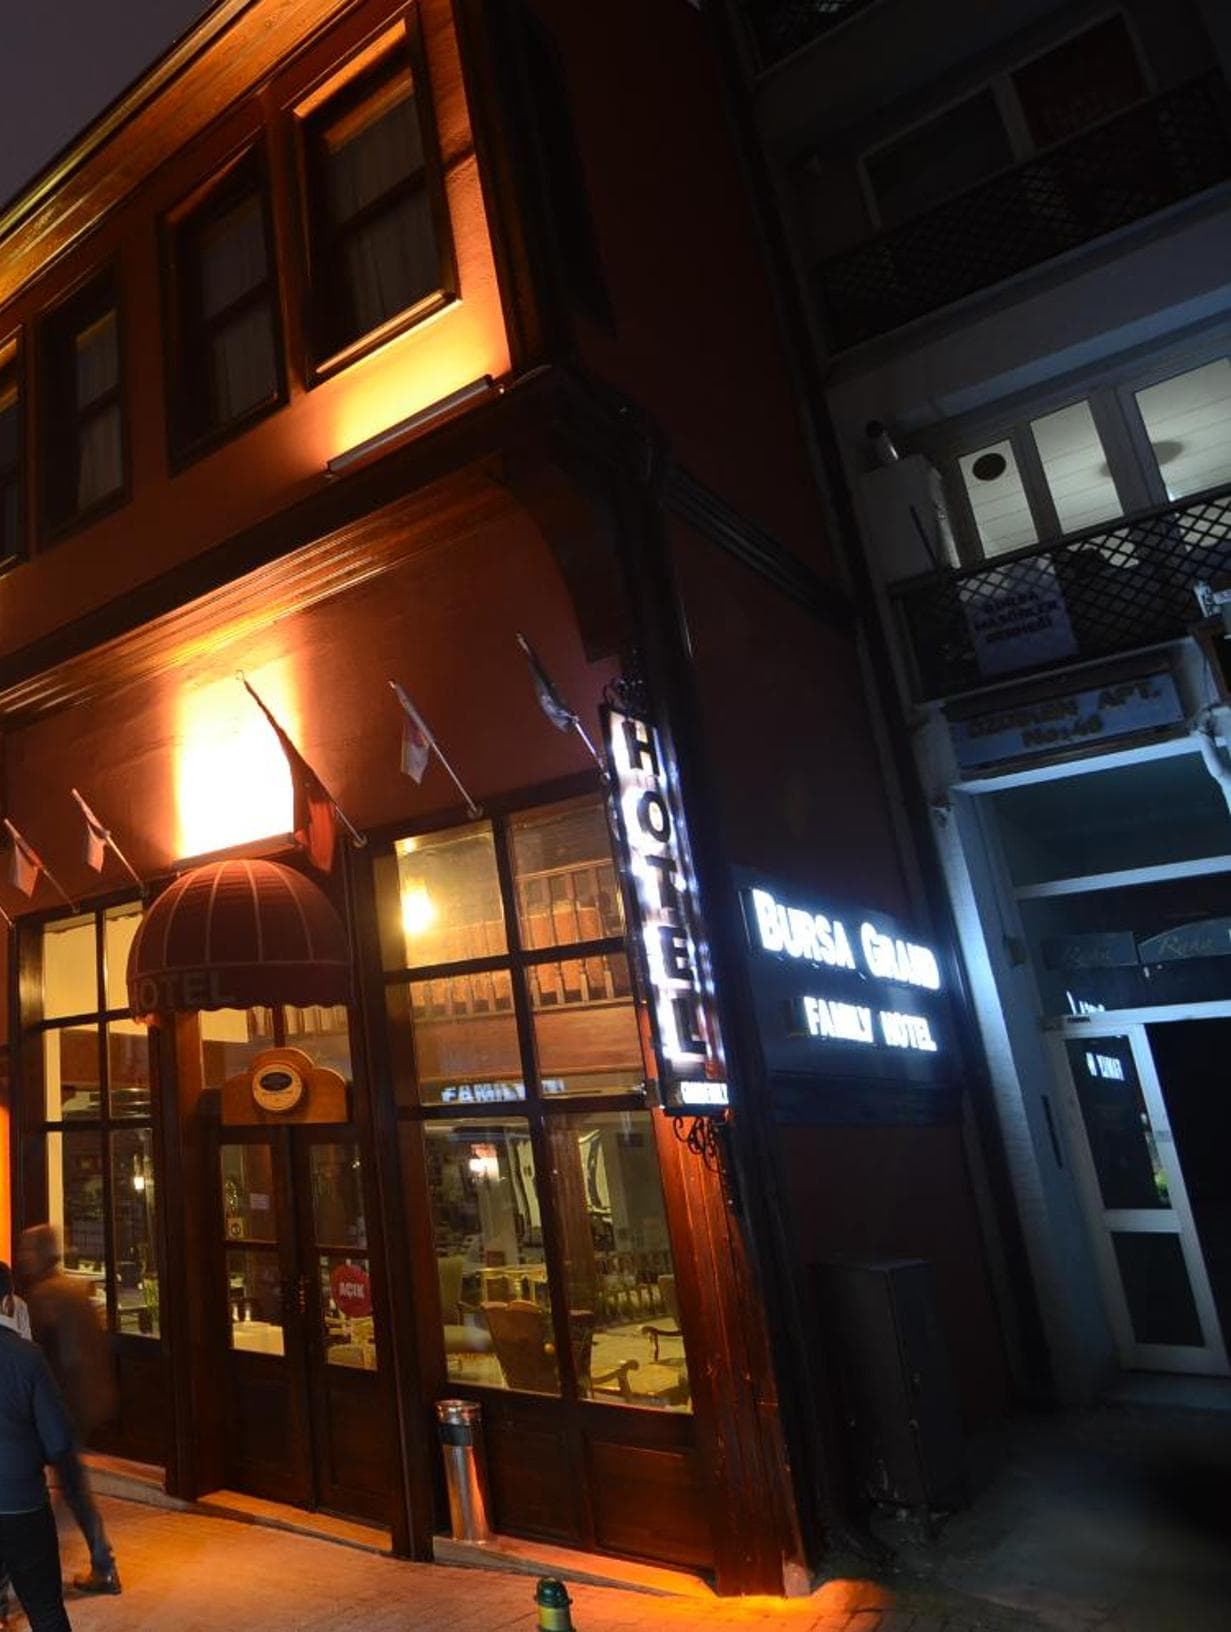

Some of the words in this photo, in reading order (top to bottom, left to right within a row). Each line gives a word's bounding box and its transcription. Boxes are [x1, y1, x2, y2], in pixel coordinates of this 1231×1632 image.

[622, 720, 707, 1055] HOTEL
[752, 888, 856, 969] BURSA
[860, 922, 940, 990] GRAND
[804, 996, 874, 1043] FAMILY
[880, 1010, 938, 1051] HOTEL
